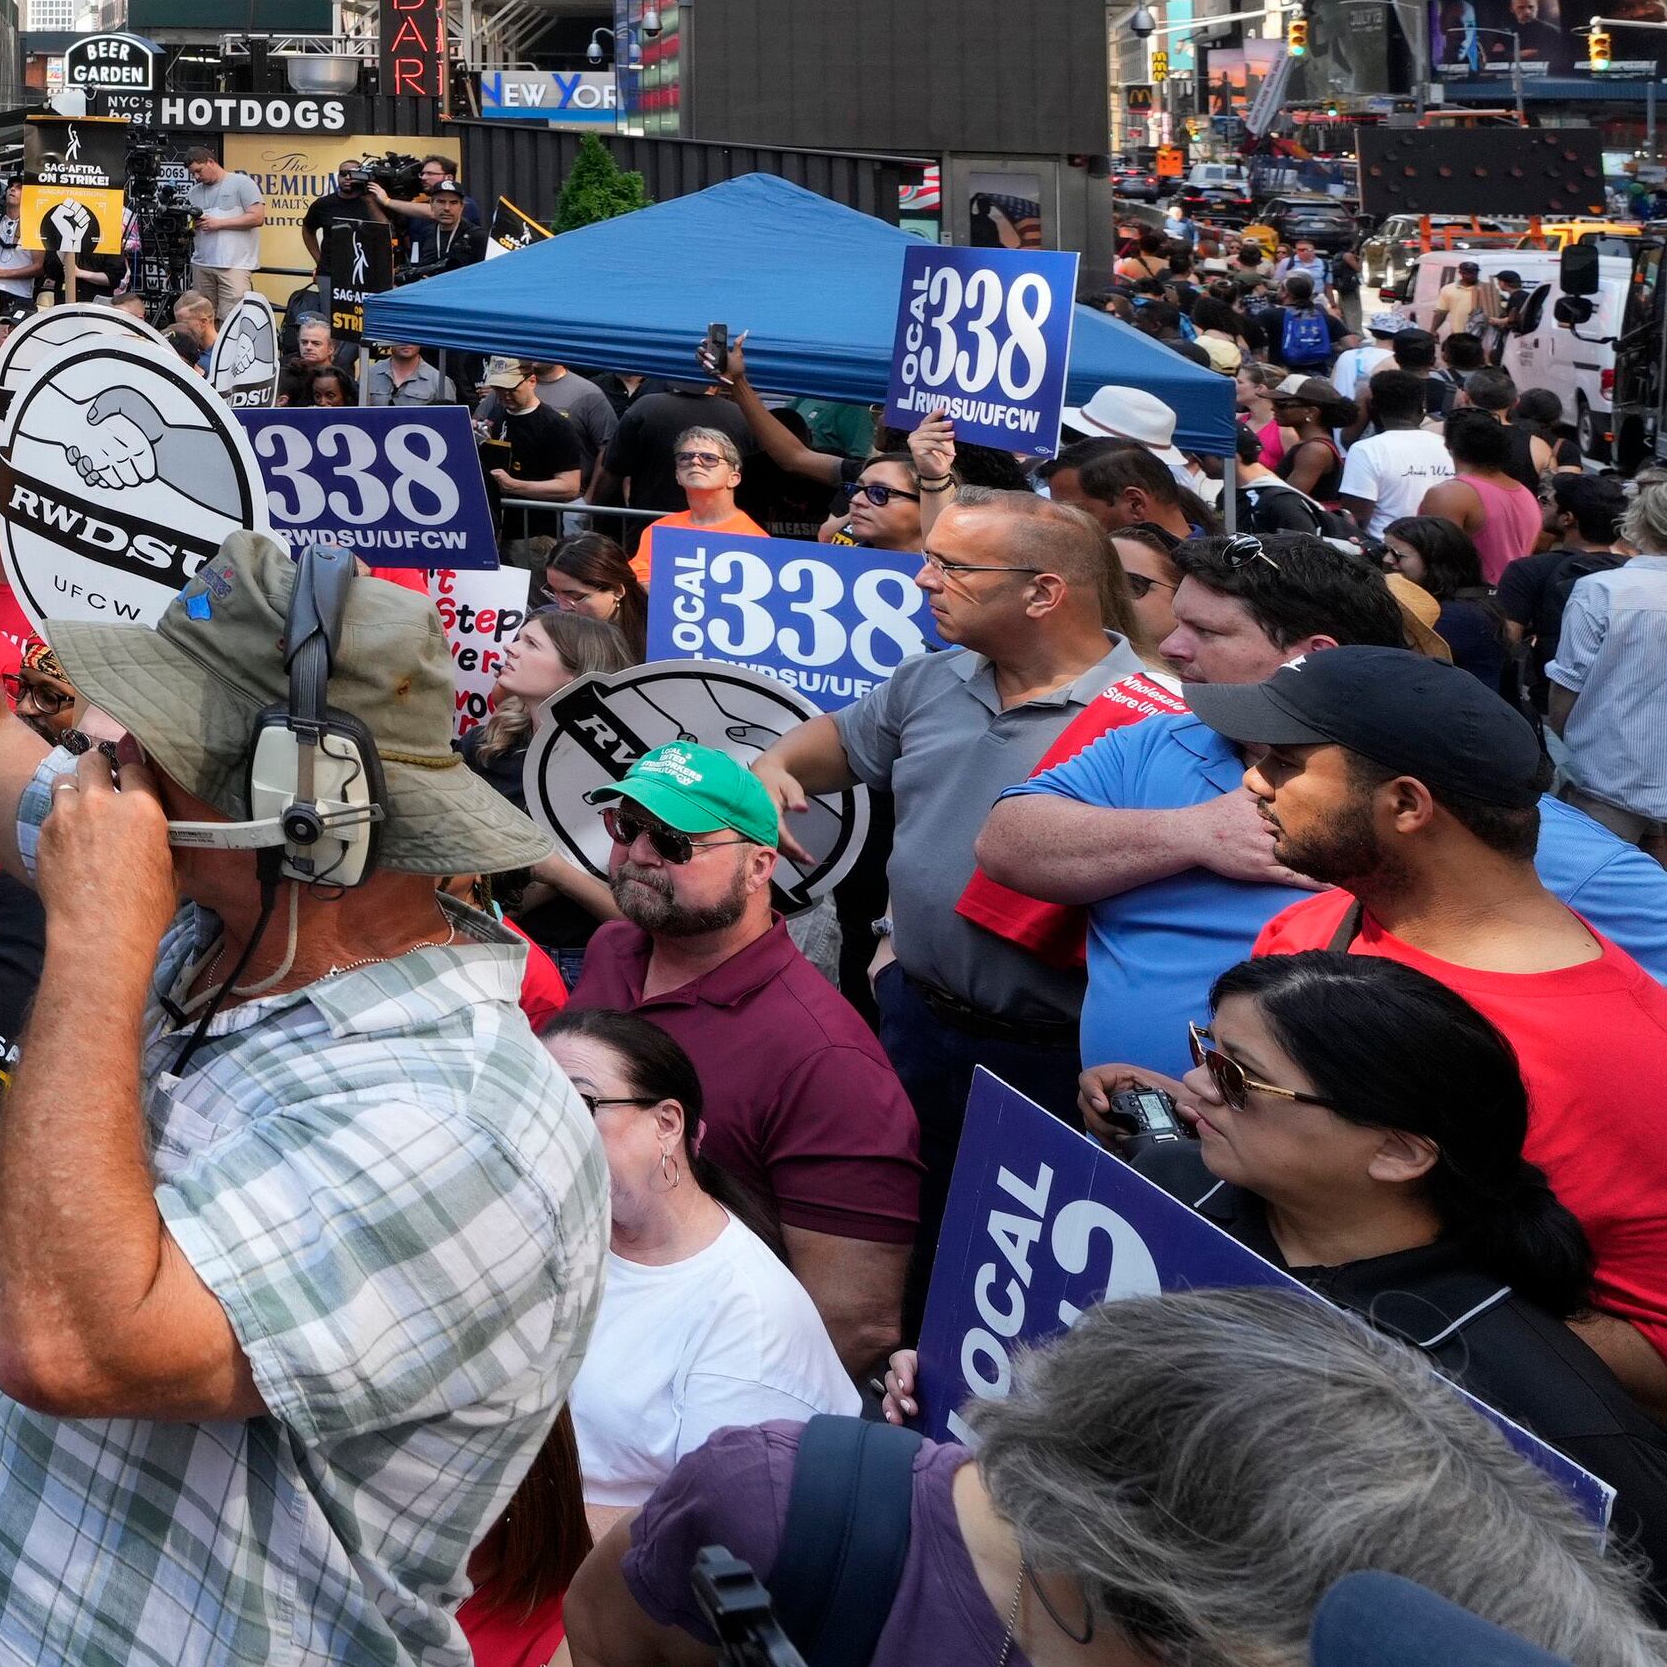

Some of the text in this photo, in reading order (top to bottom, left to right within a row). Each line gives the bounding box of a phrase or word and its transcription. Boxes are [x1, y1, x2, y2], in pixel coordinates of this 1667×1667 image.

[87, 42, 129, 61] BEER
[74, 65, 143, 83] GARDEN
[482, 72, 547, 107] NEW
[107, 96, 345, 129] NYC's HOTDOGS
[262, 151, 318, 172] The
[38, 172, 110, 187] ON STRIKE!
[898, 266, 1053, 410] LOCAL 338
[915, 391, 1041, 433] RWDSU/UFCW
[267, 424, 460, 526] 338
[55, 575, 140, 620] UFCW
[708, 550, 927, 677] 338
[436, 598, 523, 643] Step
[1103, 687, 1139, 709] Store
